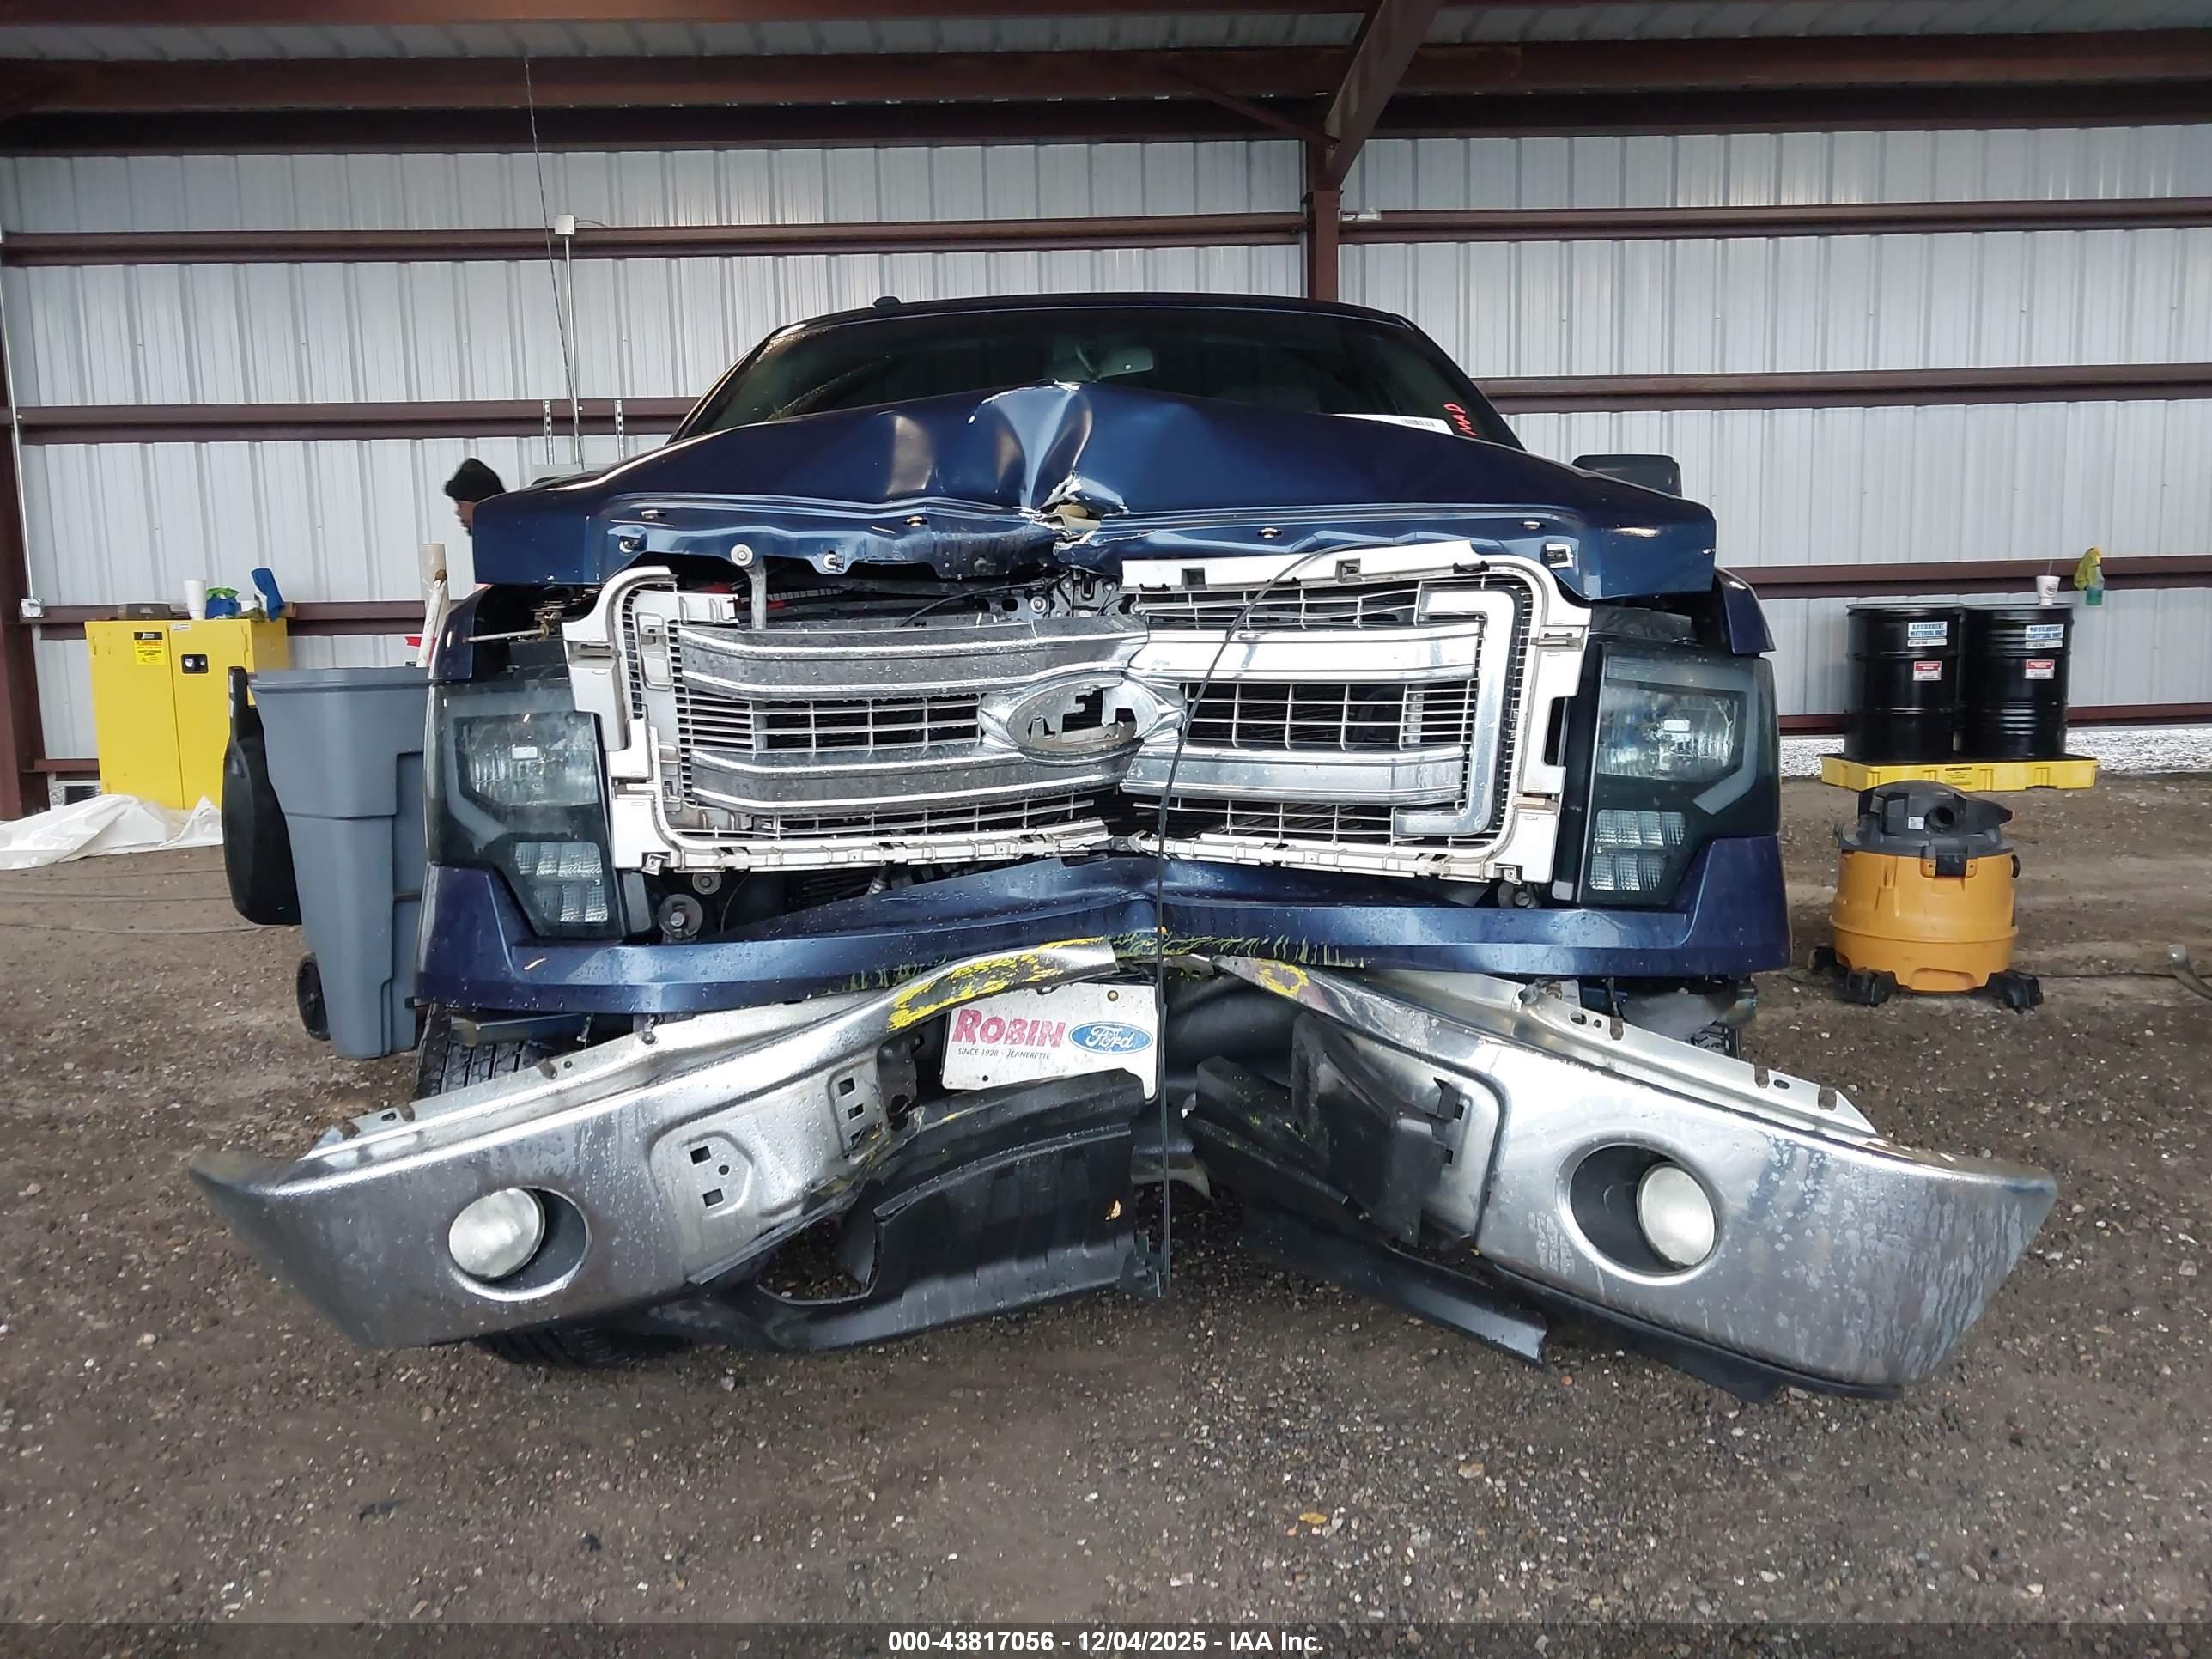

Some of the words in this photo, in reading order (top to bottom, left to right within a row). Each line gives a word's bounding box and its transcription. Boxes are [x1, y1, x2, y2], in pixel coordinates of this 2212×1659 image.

[951, 1008, 1066, 1048] ROBIN
[1085, 1025, 1134, 1048] Ford
[957, 1048, 980, 1056] SINCE
